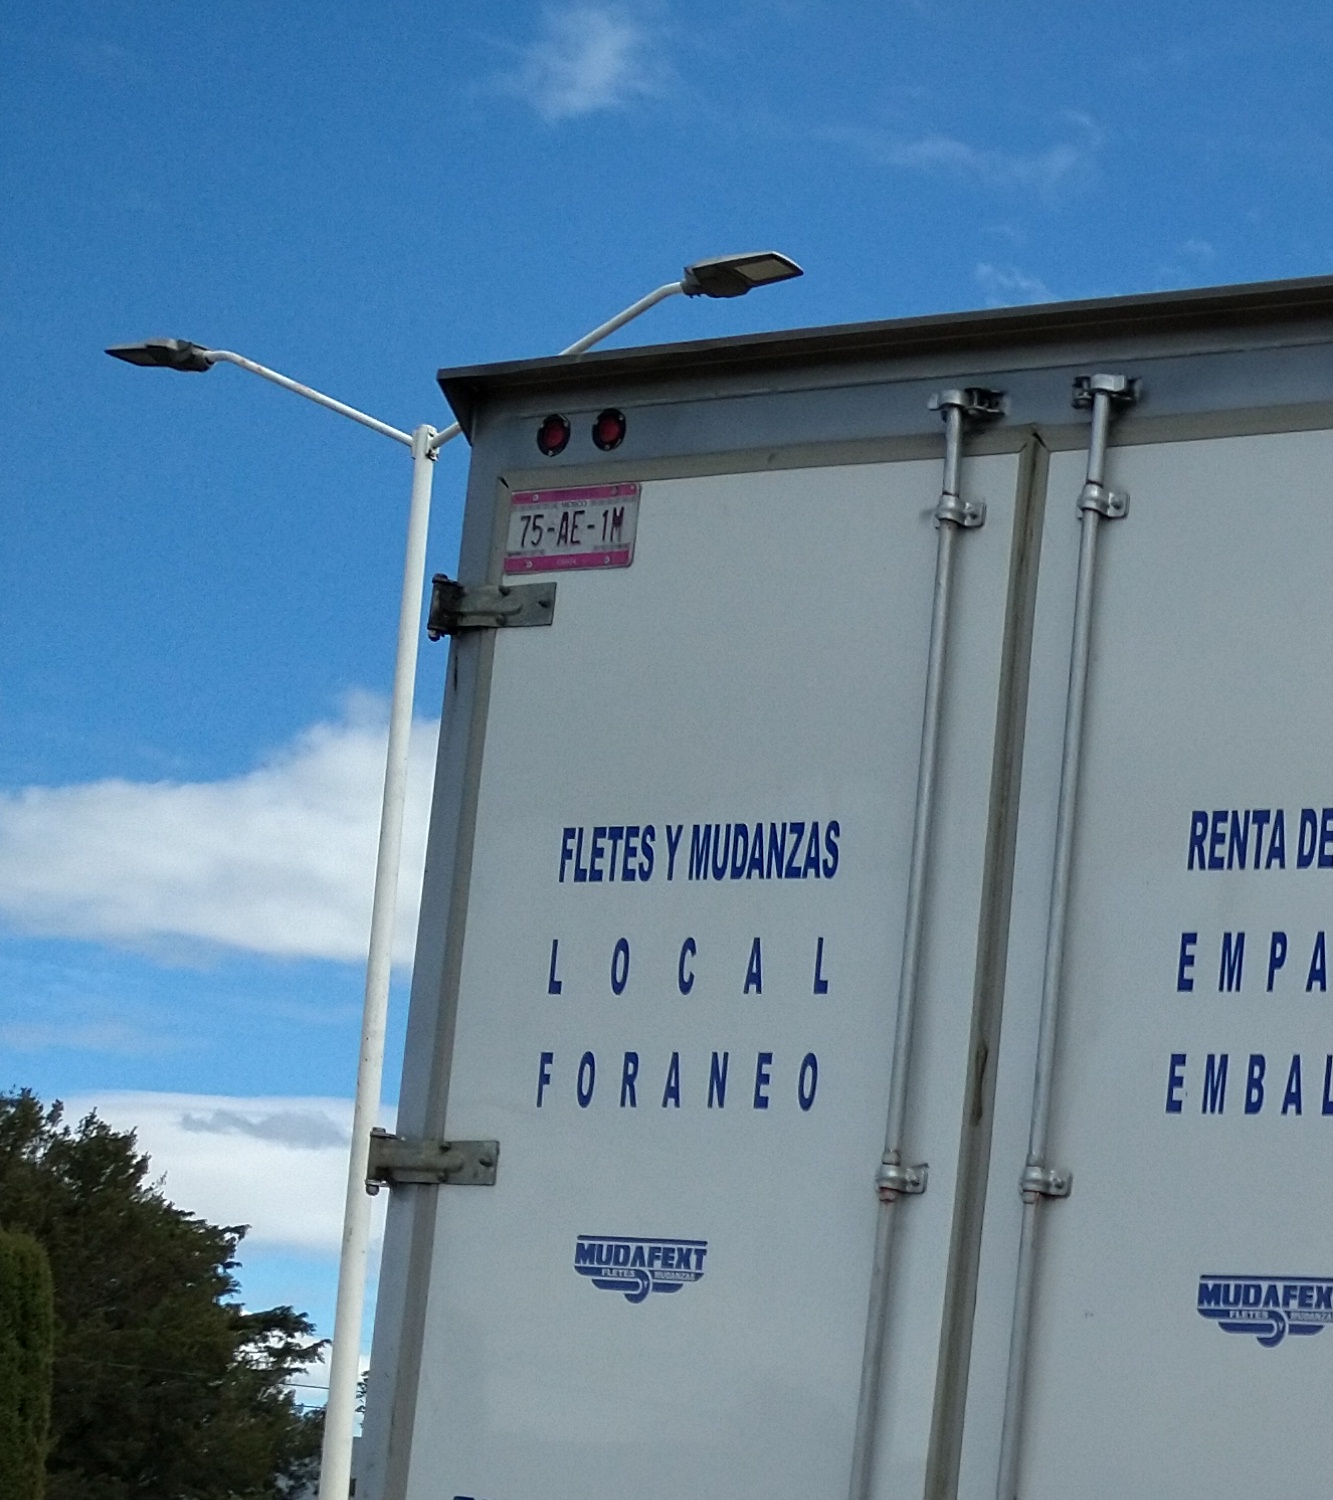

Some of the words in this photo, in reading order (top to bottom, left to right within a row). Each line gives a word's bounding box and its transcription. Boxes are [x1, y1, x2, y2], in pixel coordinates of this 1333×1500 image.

[520, 506, 625, 548] 75-AE-1M
[558, 824, 656, 883] FLETES
[665, 824, 684, 881] Y
[688, 820, 841, 882] MUDANZAS
[1187, 809, 1286, 870] RENTA
[548, 937, 829, 996] LOCAL
[536, 1051, 819, 1112] FORANEO
[574, 1242, 708, 1271] MUDAFEXT
